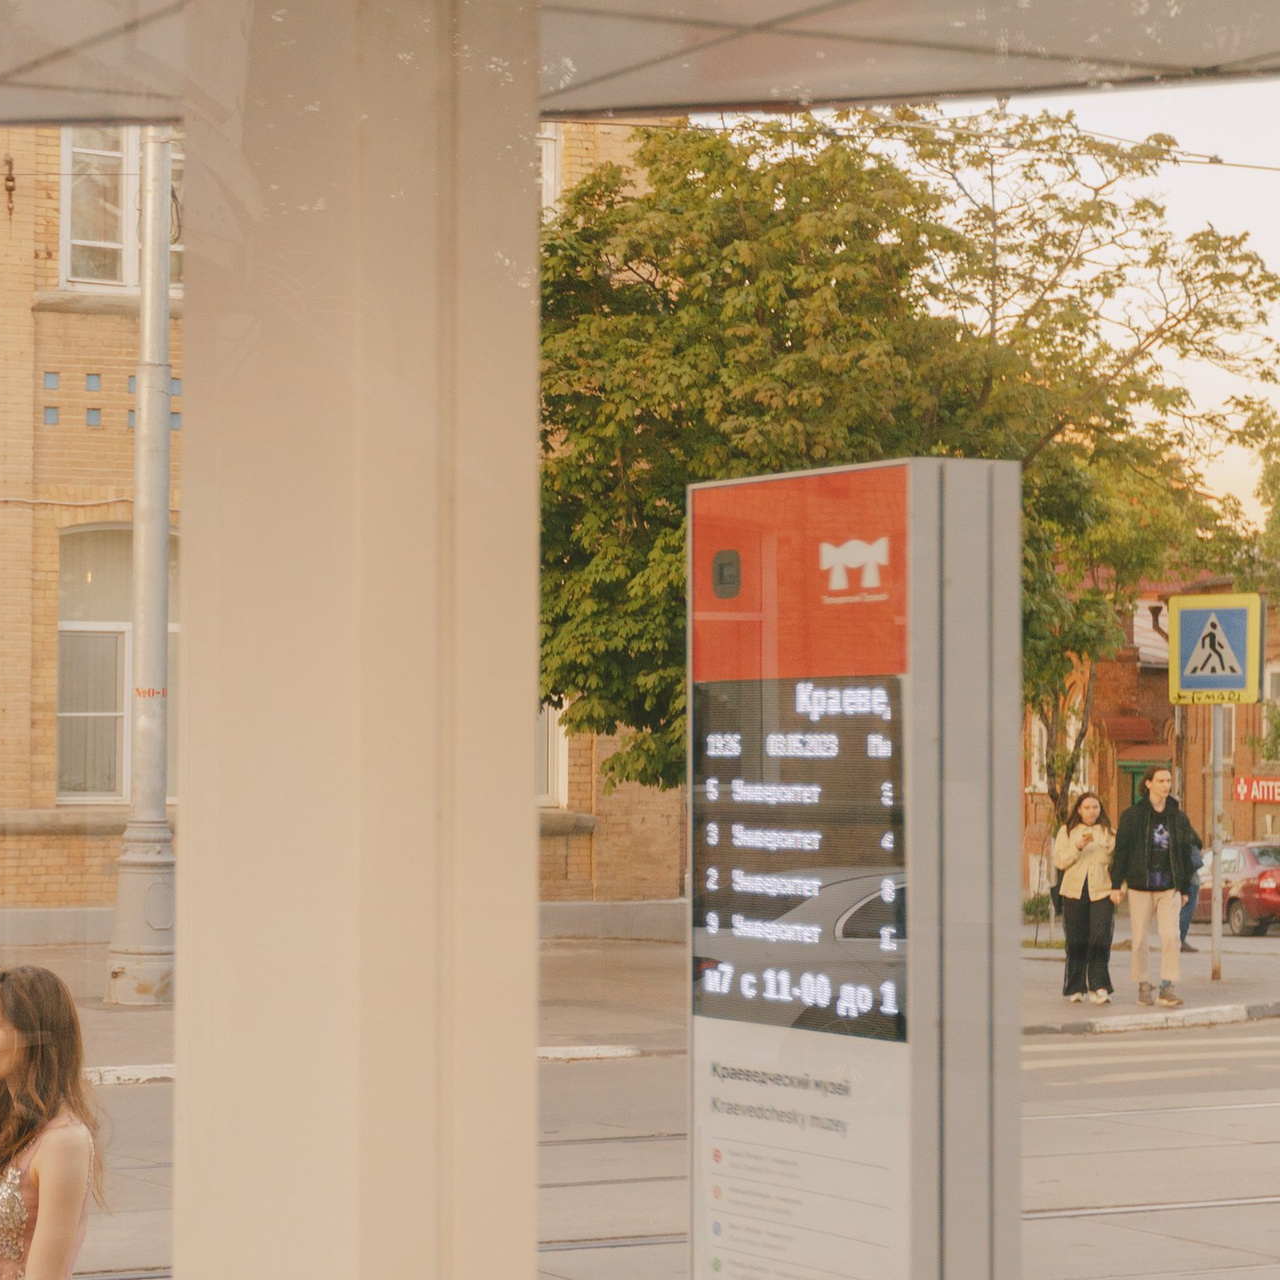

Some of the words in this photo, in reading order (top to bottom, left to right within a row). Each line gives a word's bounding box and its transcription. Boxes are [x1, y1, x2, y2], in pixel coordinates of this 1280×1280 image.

[796, 682, 891, 721] Краеве
[706, 866, 719, 892] 2
[836, 982, 873, 1018] до
[711, 1061, 810, 1090] Краеведческий
